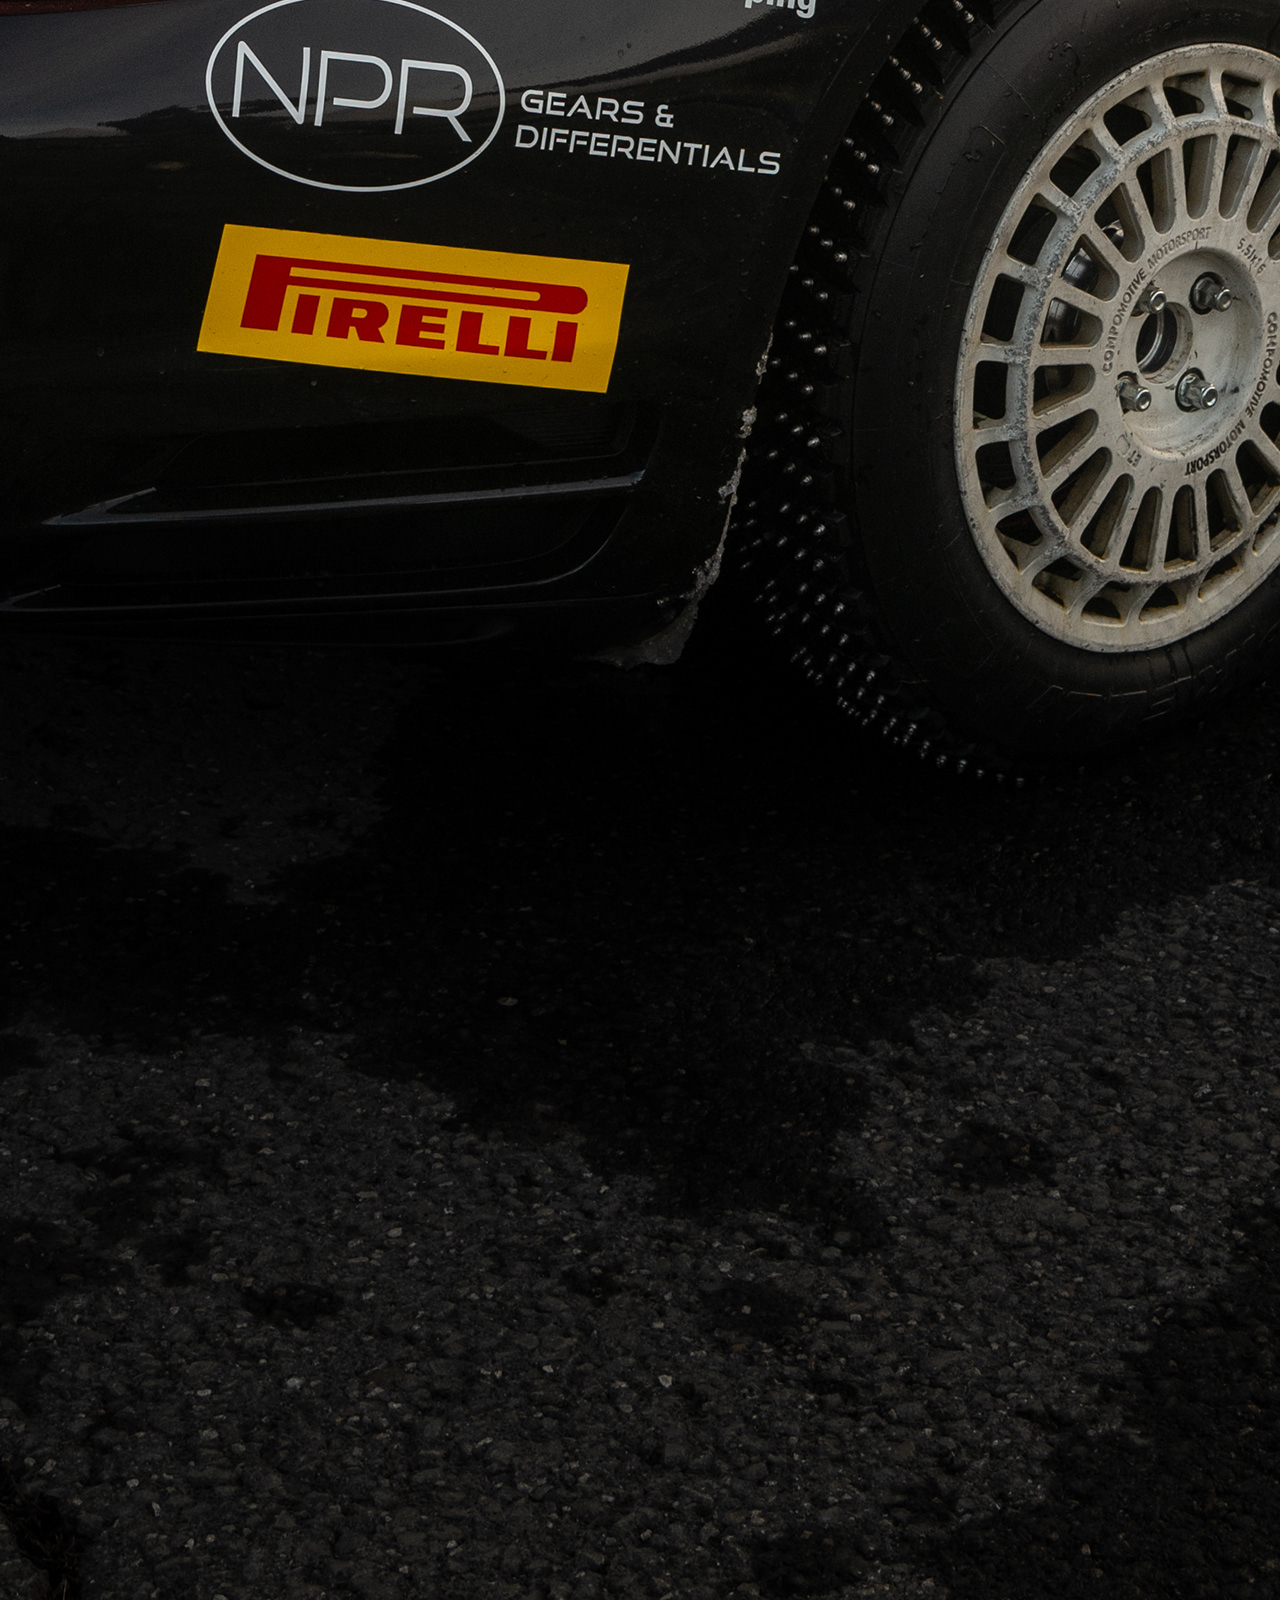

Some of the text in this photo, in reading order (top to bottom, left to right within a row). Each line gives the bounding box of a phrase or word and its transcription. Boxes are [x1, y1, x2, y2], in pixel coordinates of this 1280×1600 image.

[231, 40, 675, 143] NPR GEARS &
[514, 124, 782, 175] DIFFERENTIALS
[240, 253, 589, 364] PIRELLI
[1102, 225, 1212, 375] COMPOMOTIVE MOTORSPORT
[1185, 421, 1246, 476] MOTORSPORT
